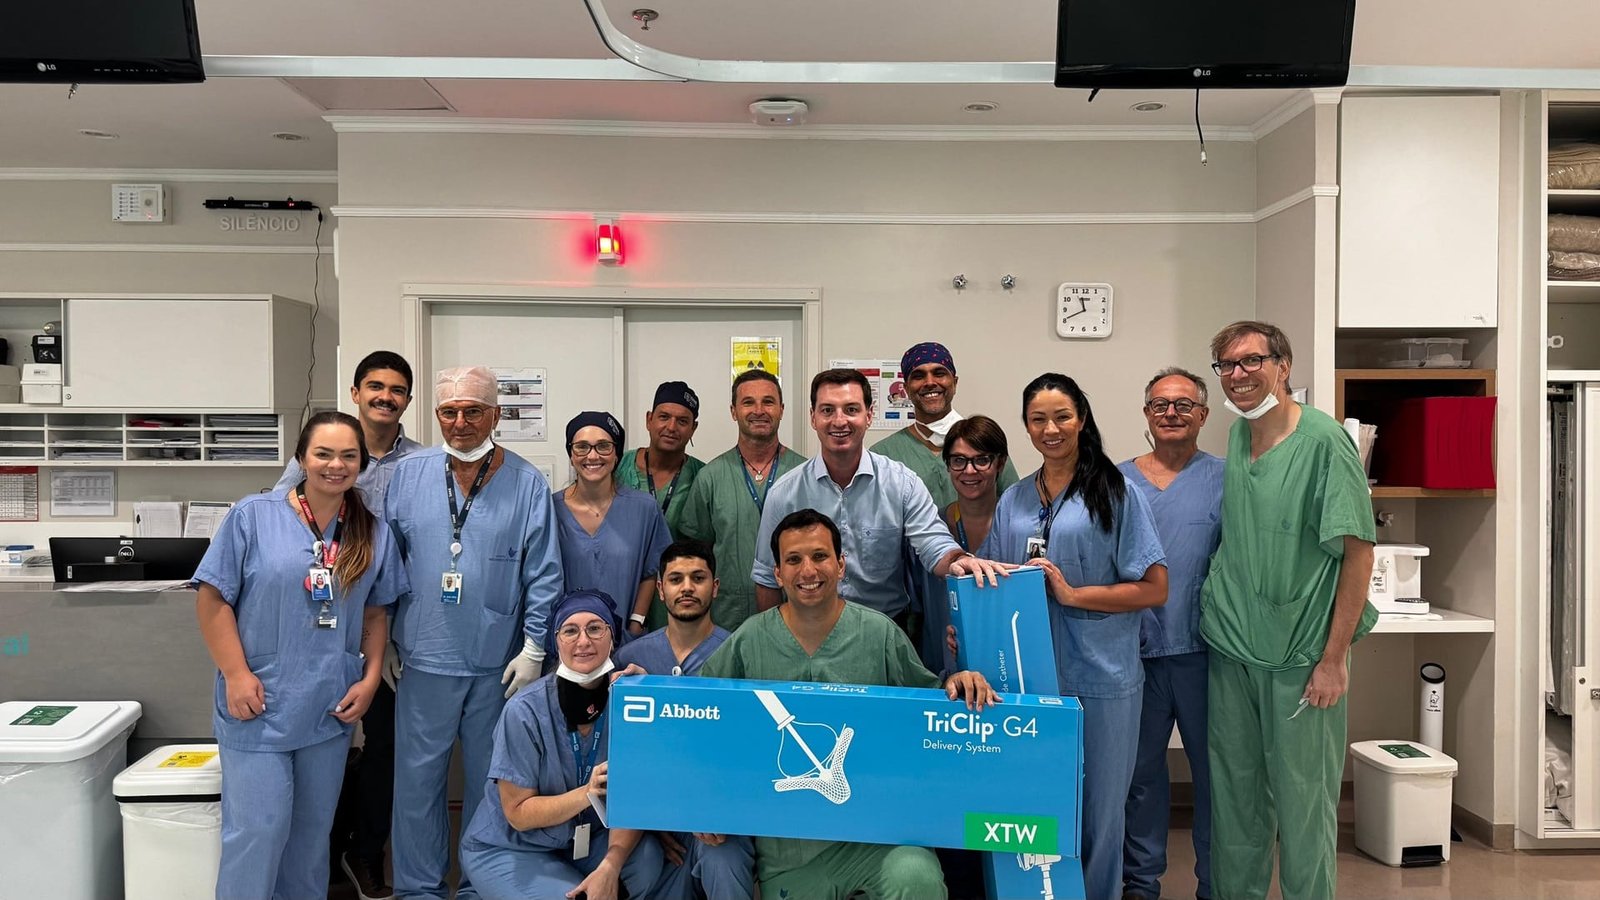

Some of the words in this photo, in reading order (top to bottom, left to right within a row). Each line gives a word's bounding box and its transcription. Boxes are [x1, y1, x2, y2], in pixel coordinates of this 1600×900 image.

[221, 213, 300, 231] SILÊNCIO
[999, 650, 1007, 682] Catheter
[659, 703, 720, 720] Abbott
[1003, 715, 1039, 738] G4
[923, 739, 963, 753] Delivery
[965, 741, 1001, 755] System
[983, 822, 1038, 844] XTW
